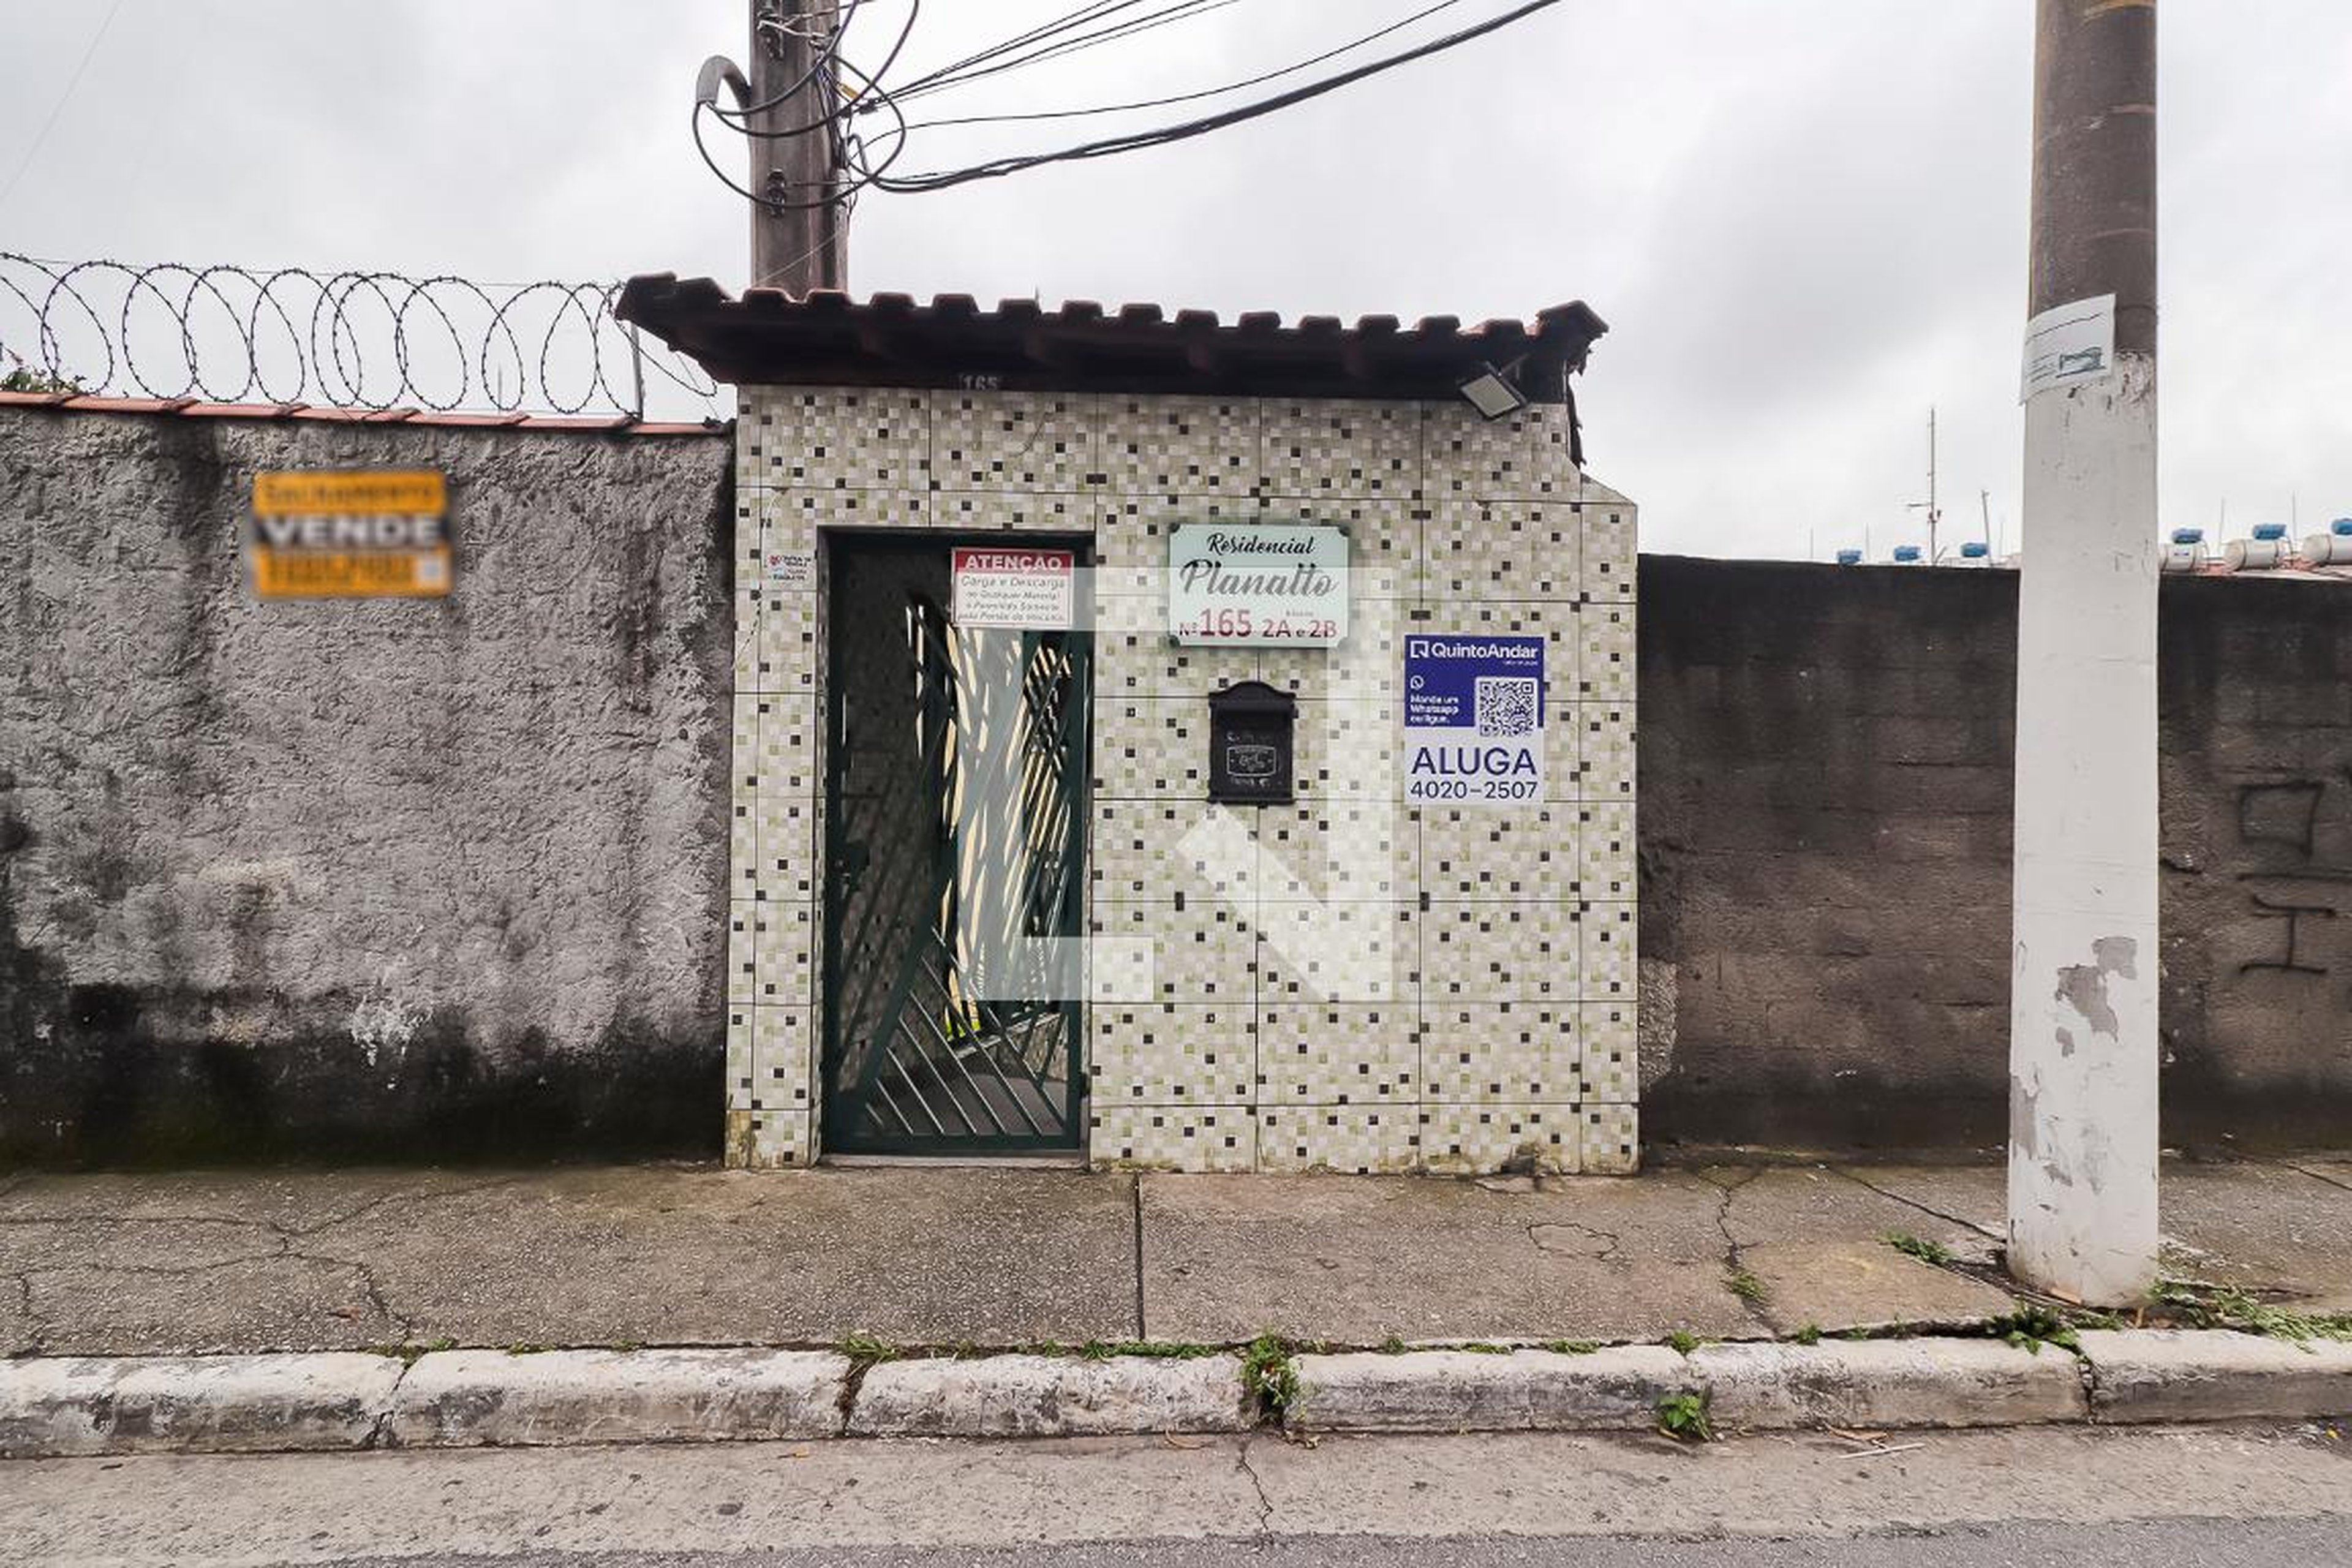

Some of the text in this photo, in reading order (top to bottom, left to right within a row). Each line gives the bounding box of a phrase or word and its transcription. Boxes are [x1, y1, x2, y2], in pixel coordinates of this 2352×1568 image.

[263, 514, 440, 546] VENDE
[1206, 532, 1316, 556] Residencial
[961, 576, 997, 588] Carga
[1011, 576, 1065, 590] Descarga
[1200, 608, 1253, 638] 165
[1262, 619, 1291, 638] 2A
[1296, 629, 1305, 638] e
[1309, 619, 1337, 638] 2B
[1431, 643, 1538, 658] QuintoAndar
[1411, 747, 1537, 776] ALUGA
[1410, 781, 1538, 799] 4020-2507
